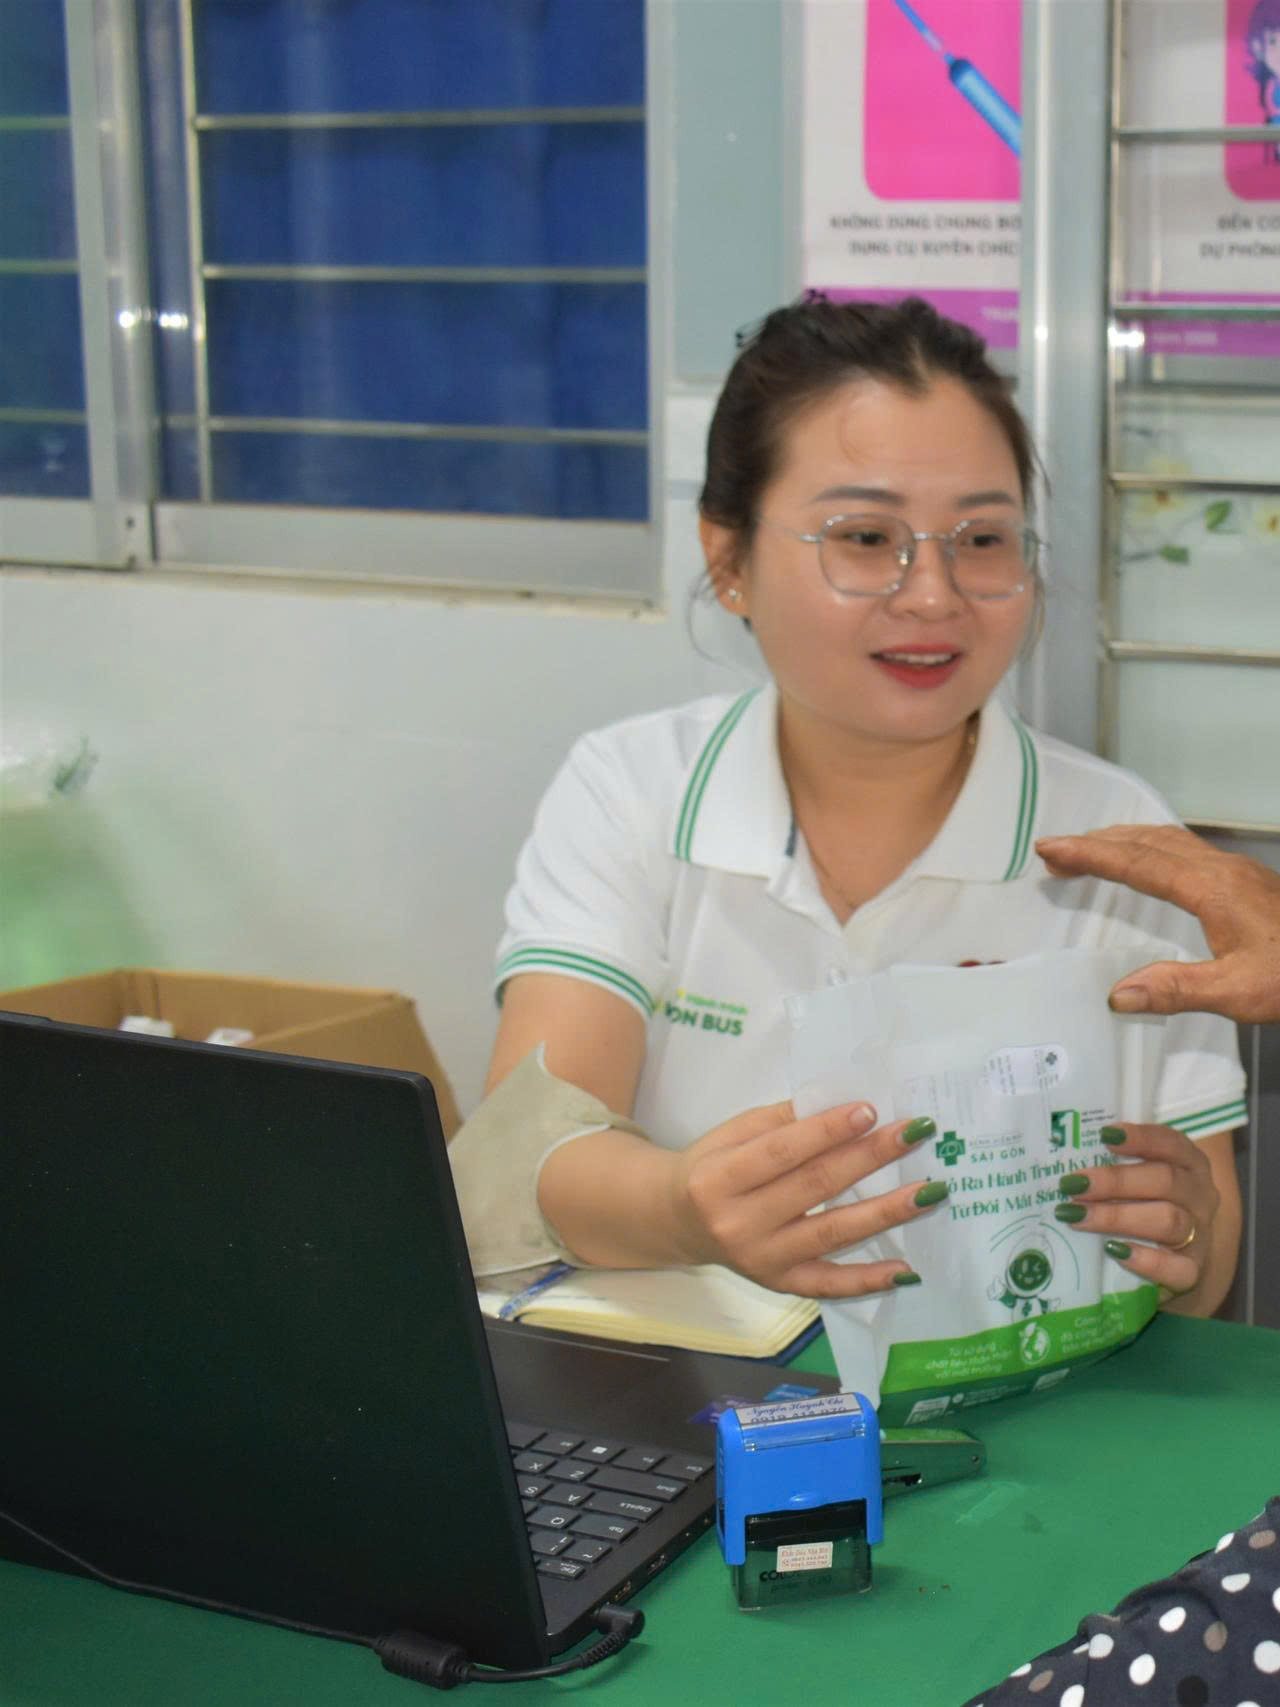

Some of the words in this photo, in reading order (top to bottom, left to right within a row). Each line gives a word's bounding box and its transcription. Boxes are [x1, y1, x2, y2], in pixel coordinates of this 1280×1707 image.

[702, 1012, 743, 1037] BUS
[962, 1176, 984, 1194] Ra
[525, 1486, 538, 1494] S
[567, 1494, 581, 1502] A
